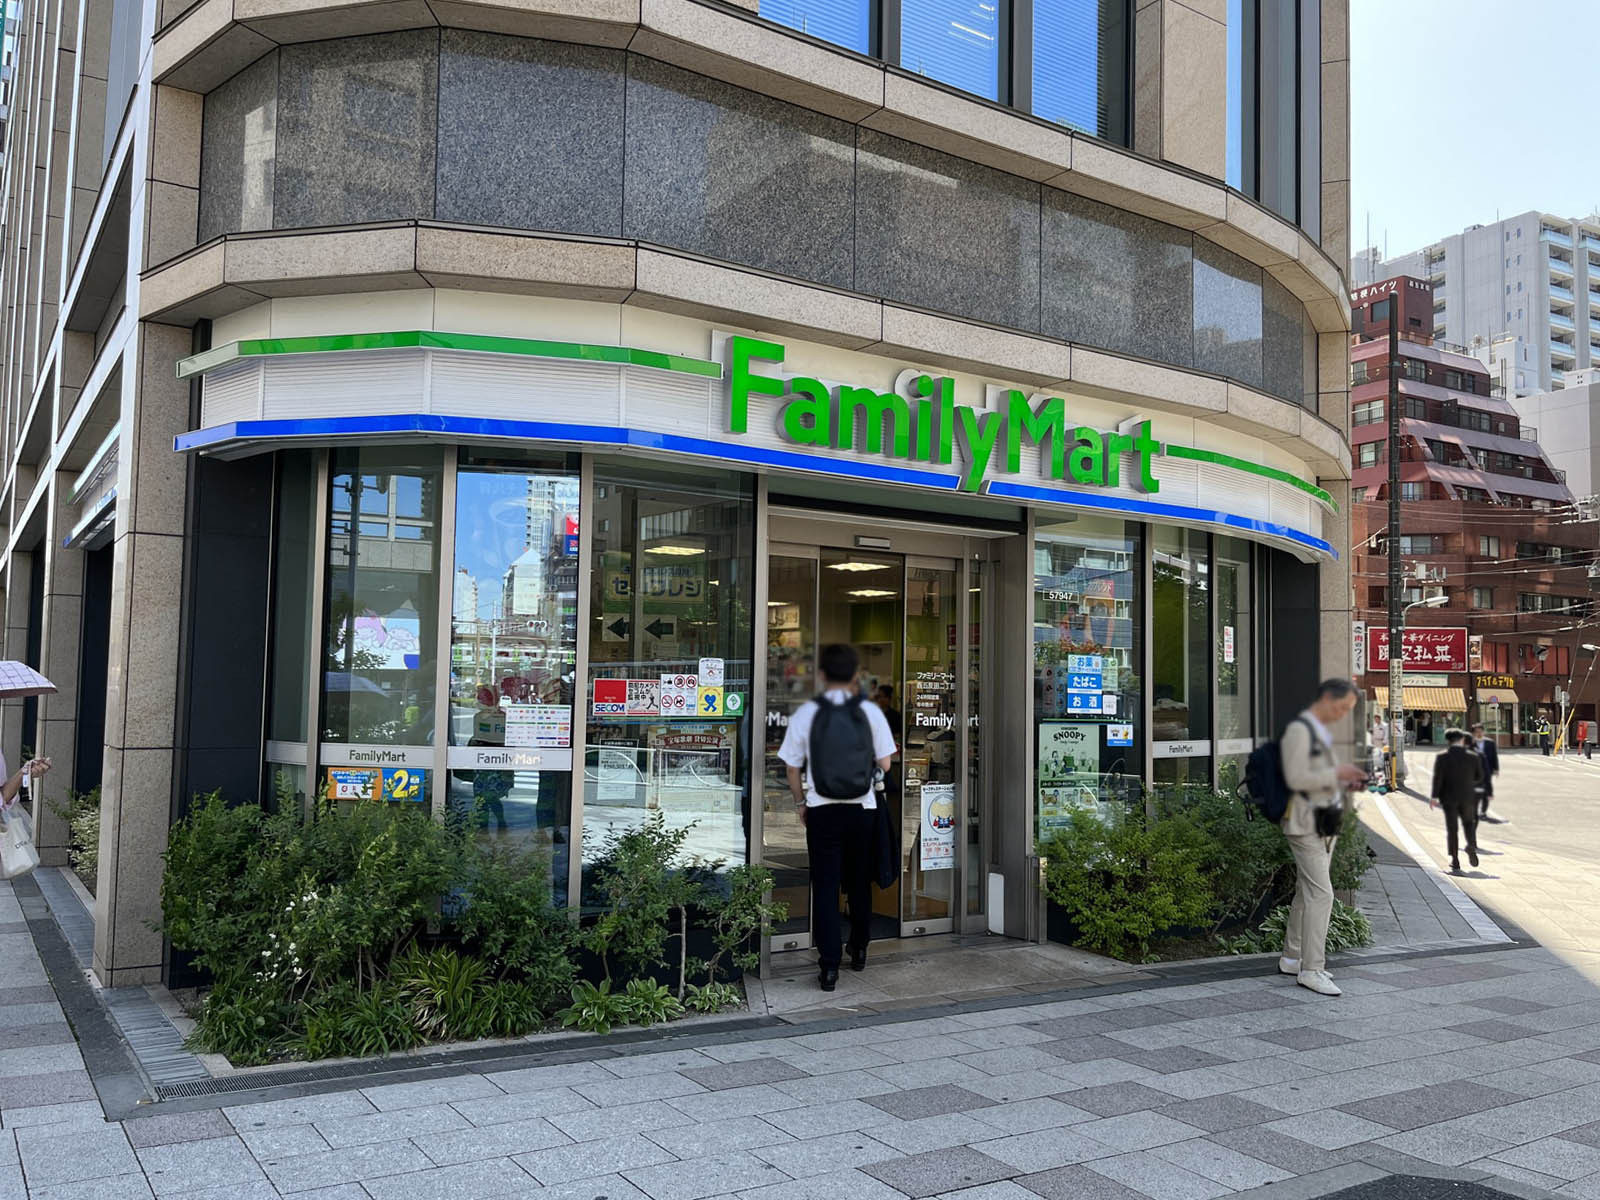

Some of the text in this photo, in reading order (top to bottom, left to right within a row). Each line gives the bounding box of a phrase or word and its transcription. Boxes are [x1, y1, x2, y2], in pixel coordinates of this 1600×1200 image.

[727, 335, 1160, 494] FamilyMart
[1049, 591, 1073, 600] 57947
[1379, 632, 1455, 643] 本中華ダイニング
[916, 672, 955, 680] ファミリーマート
[1072, 676, 1097, 687] たばこ
[1072, 696, 1097, 707] お酒
[595, 704, 625, 712] SECOM
[916, 712, 979, 730] Familyrt
[1053, 731, 1087, 742] SNOOPY
[1169, 745, 1193, 754] FamilyMart
[349, 750, 406, 764] FamilyMart
[477, 753, 543, 766] FamilyMart
[392, 769, 409, 798] 2
